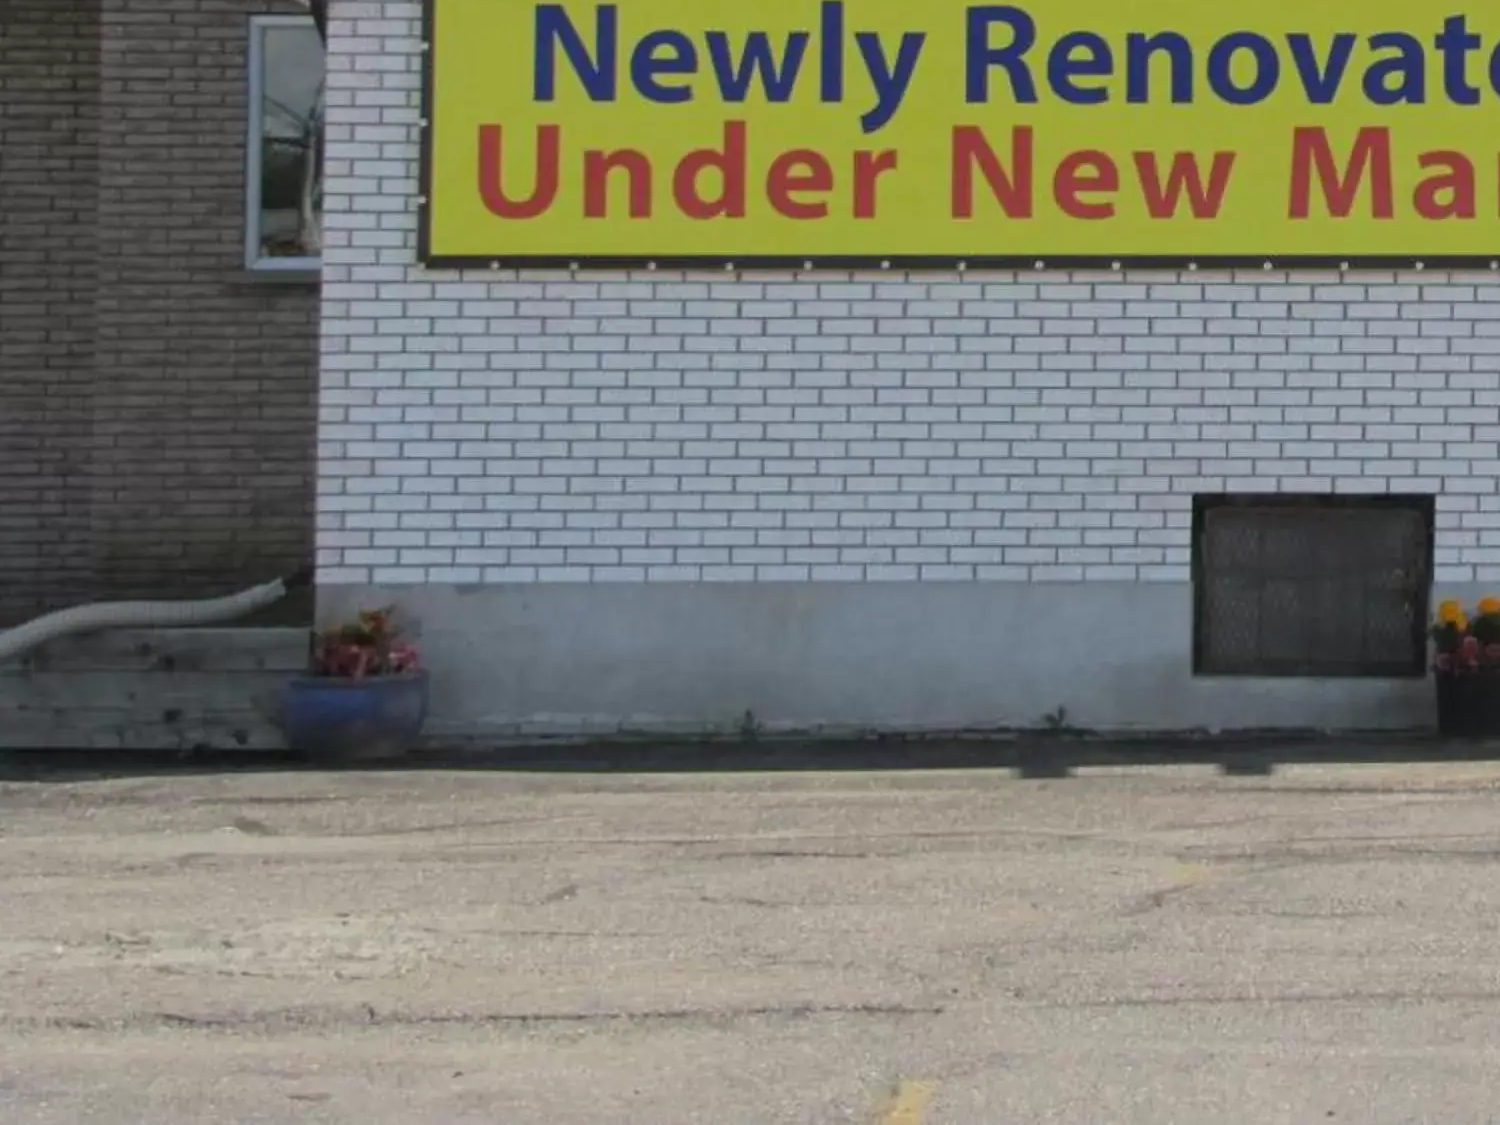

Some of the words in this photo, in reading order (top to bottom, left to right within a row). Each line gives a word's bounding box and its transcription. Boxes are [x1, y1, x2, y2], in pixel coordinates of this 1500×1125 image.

[533, 1, 926, 134] Newly
[477, 120, 898, 220] Under
[951, 125, 1236, 220] New
